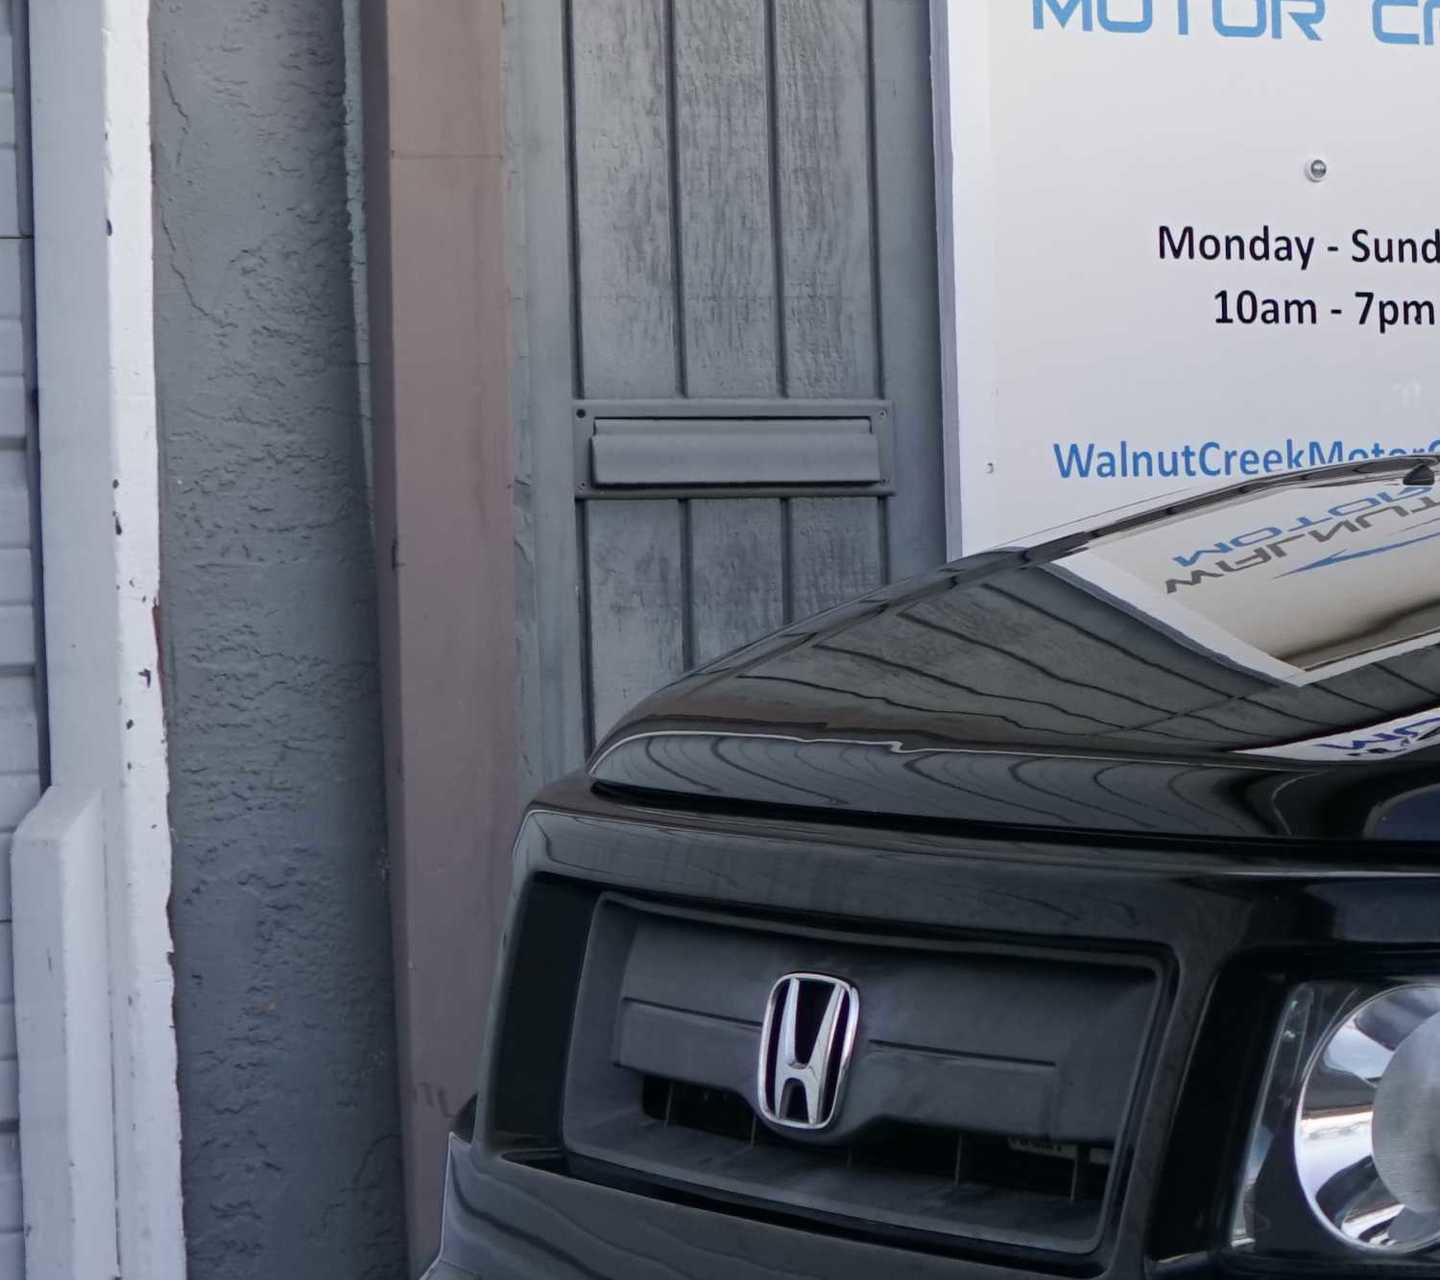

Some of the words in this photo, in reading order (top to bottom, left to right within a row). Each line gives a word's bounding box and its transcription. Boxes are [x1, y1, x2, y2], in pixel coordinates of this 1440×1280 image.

[1158, 225, 1314, 269] Monday
[1214, 291, 1318, 325] 10am
[1355, 292, 1435, 333] 7pm
